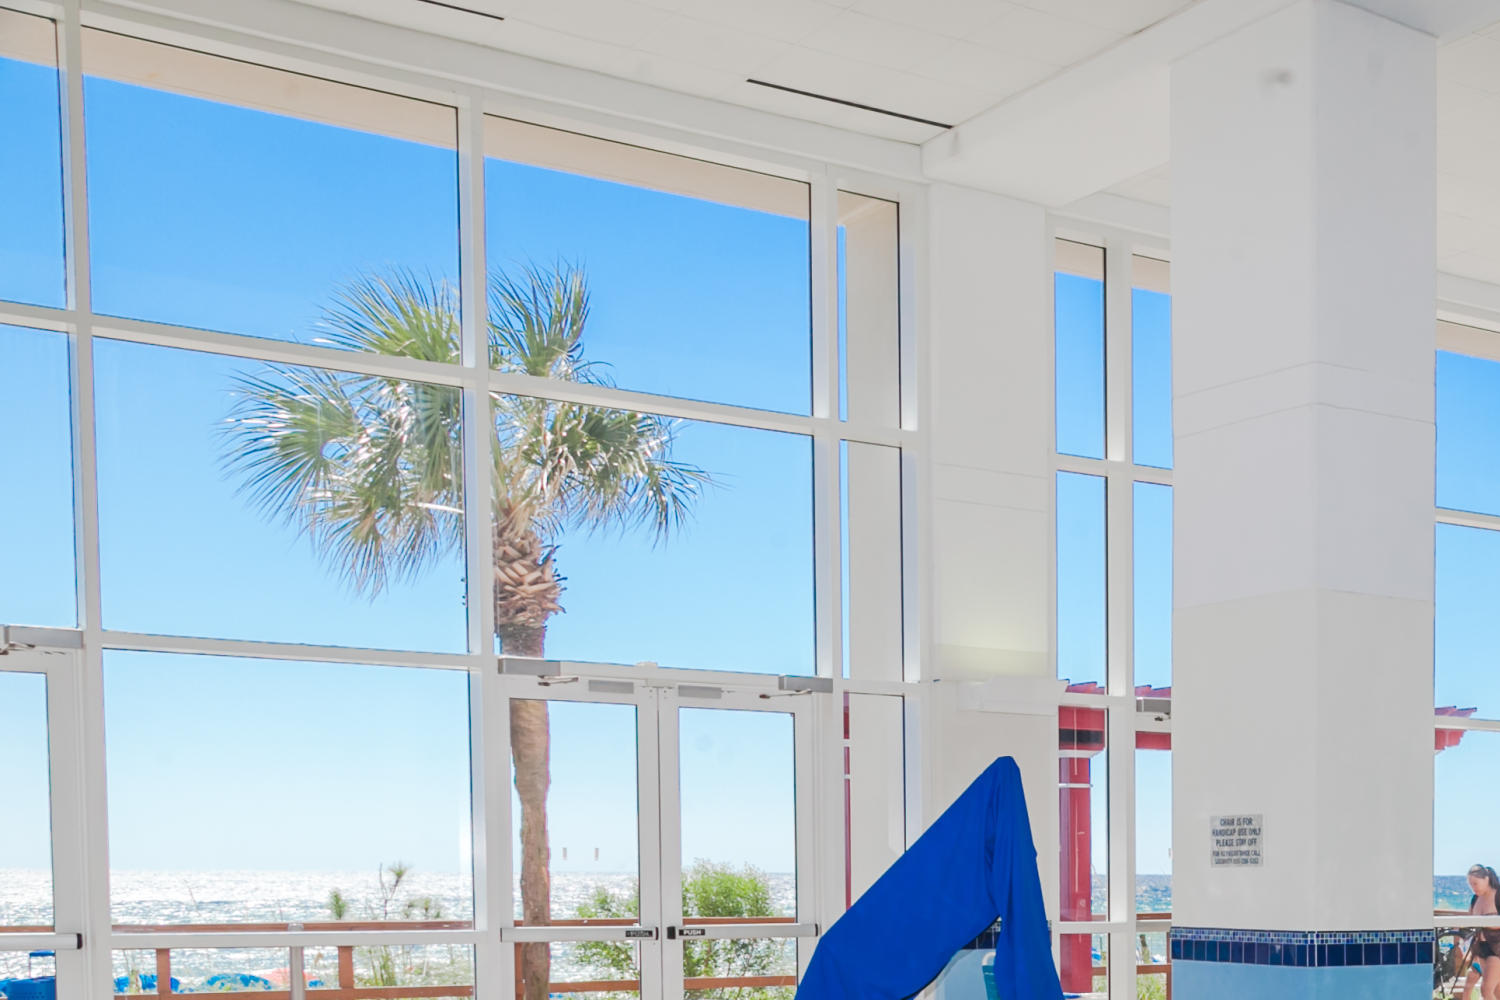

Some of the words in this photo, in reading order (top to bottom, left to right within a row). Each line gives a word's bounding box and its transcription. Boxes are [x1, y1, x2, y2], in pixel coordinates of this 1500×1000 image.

[1220, 818, 1235, 827] CHAIR
[1236, 817, 1241, 826] IS
[1242, 817, 1253, 826] FOR
[1212, 828, 1236, 837] HANDICAP
[1238, 828, 1247, 836] USE
[1249, 827, 1261, 836] ONLY
[1216, 839, 1234, 847] PLEASE
[1248, 838, 1257, 846] OFF
